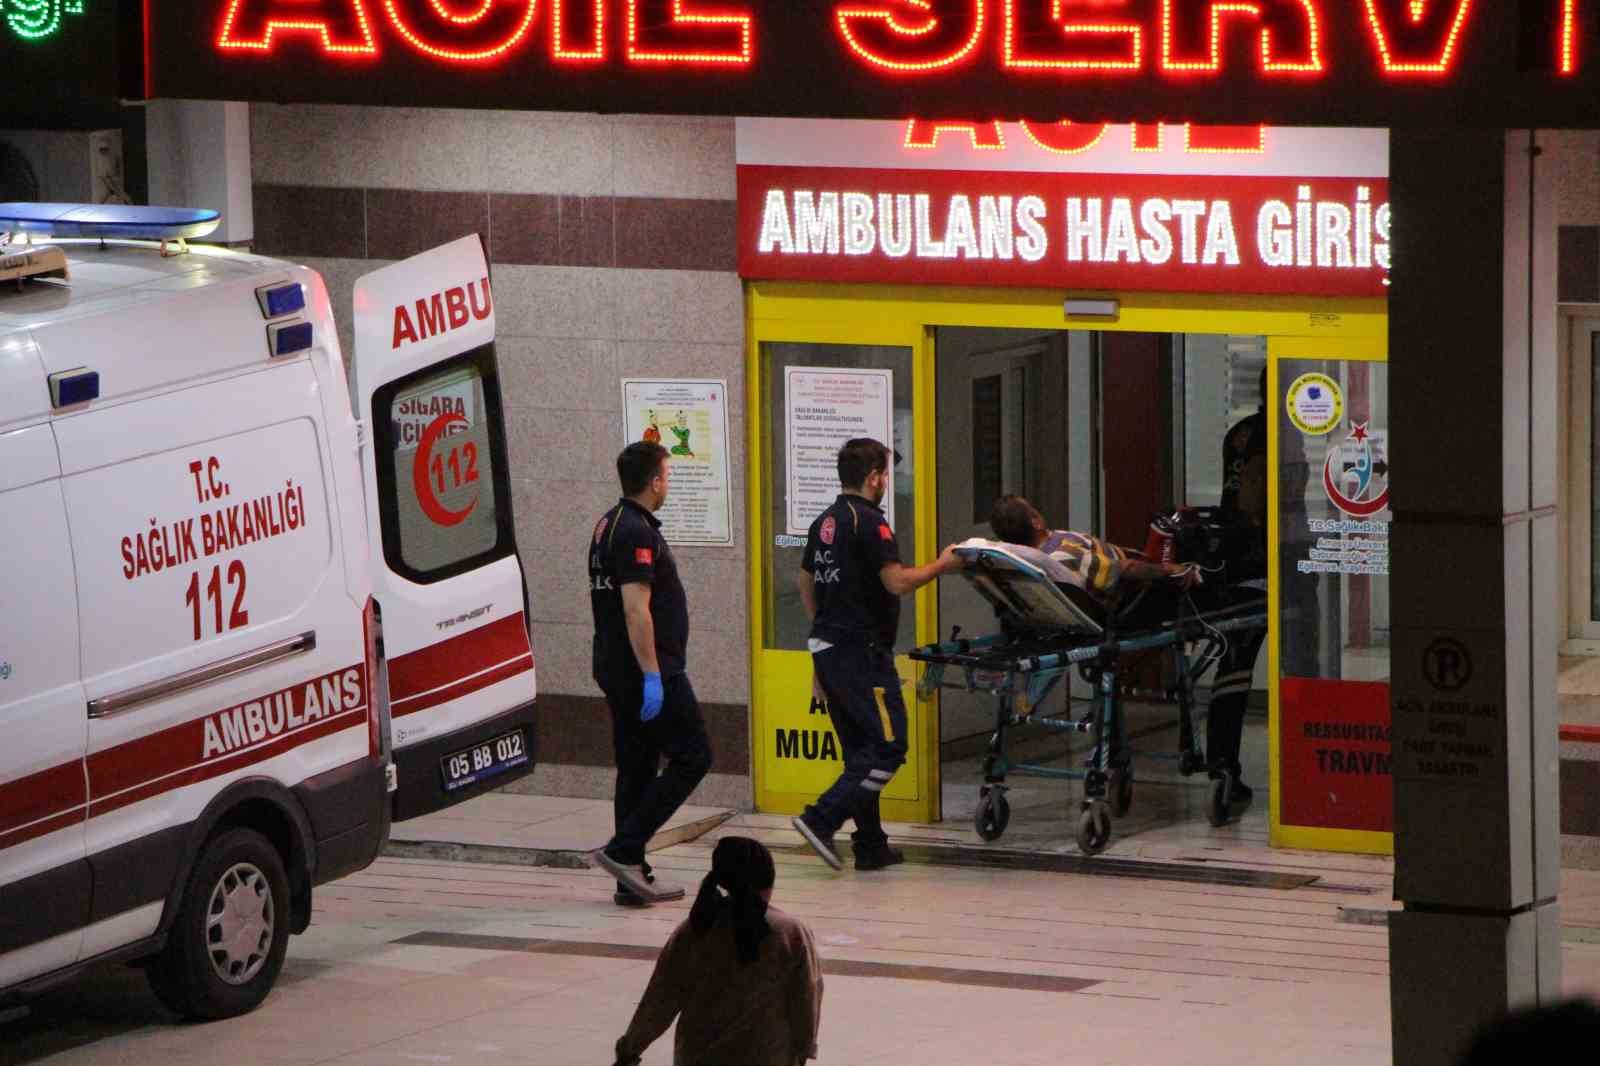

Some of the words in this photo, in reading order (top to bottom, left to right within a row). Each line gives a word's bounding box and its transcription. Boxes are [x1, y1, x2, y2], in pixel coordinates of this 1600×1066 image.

[758, 189, 1048, 262] AMBULANS
[1066, 197, 1240, 266] HASTA
[392, 277, 493, 350] AMBU
[189, 456, 230, 503] T.C.
[431, 440, 479, 493] 112
[121, 517, 197, 580] SAĞLIK
[201, 479, 305, 557] BAKANLIĞI
[185, 559, 249, 641] 112
[202, 668, 363, 759] AMBULANS
[449, 753, 470, 779] 05
[473, 745, 492, 771] BB
[496, 735, 522, 761] 012
